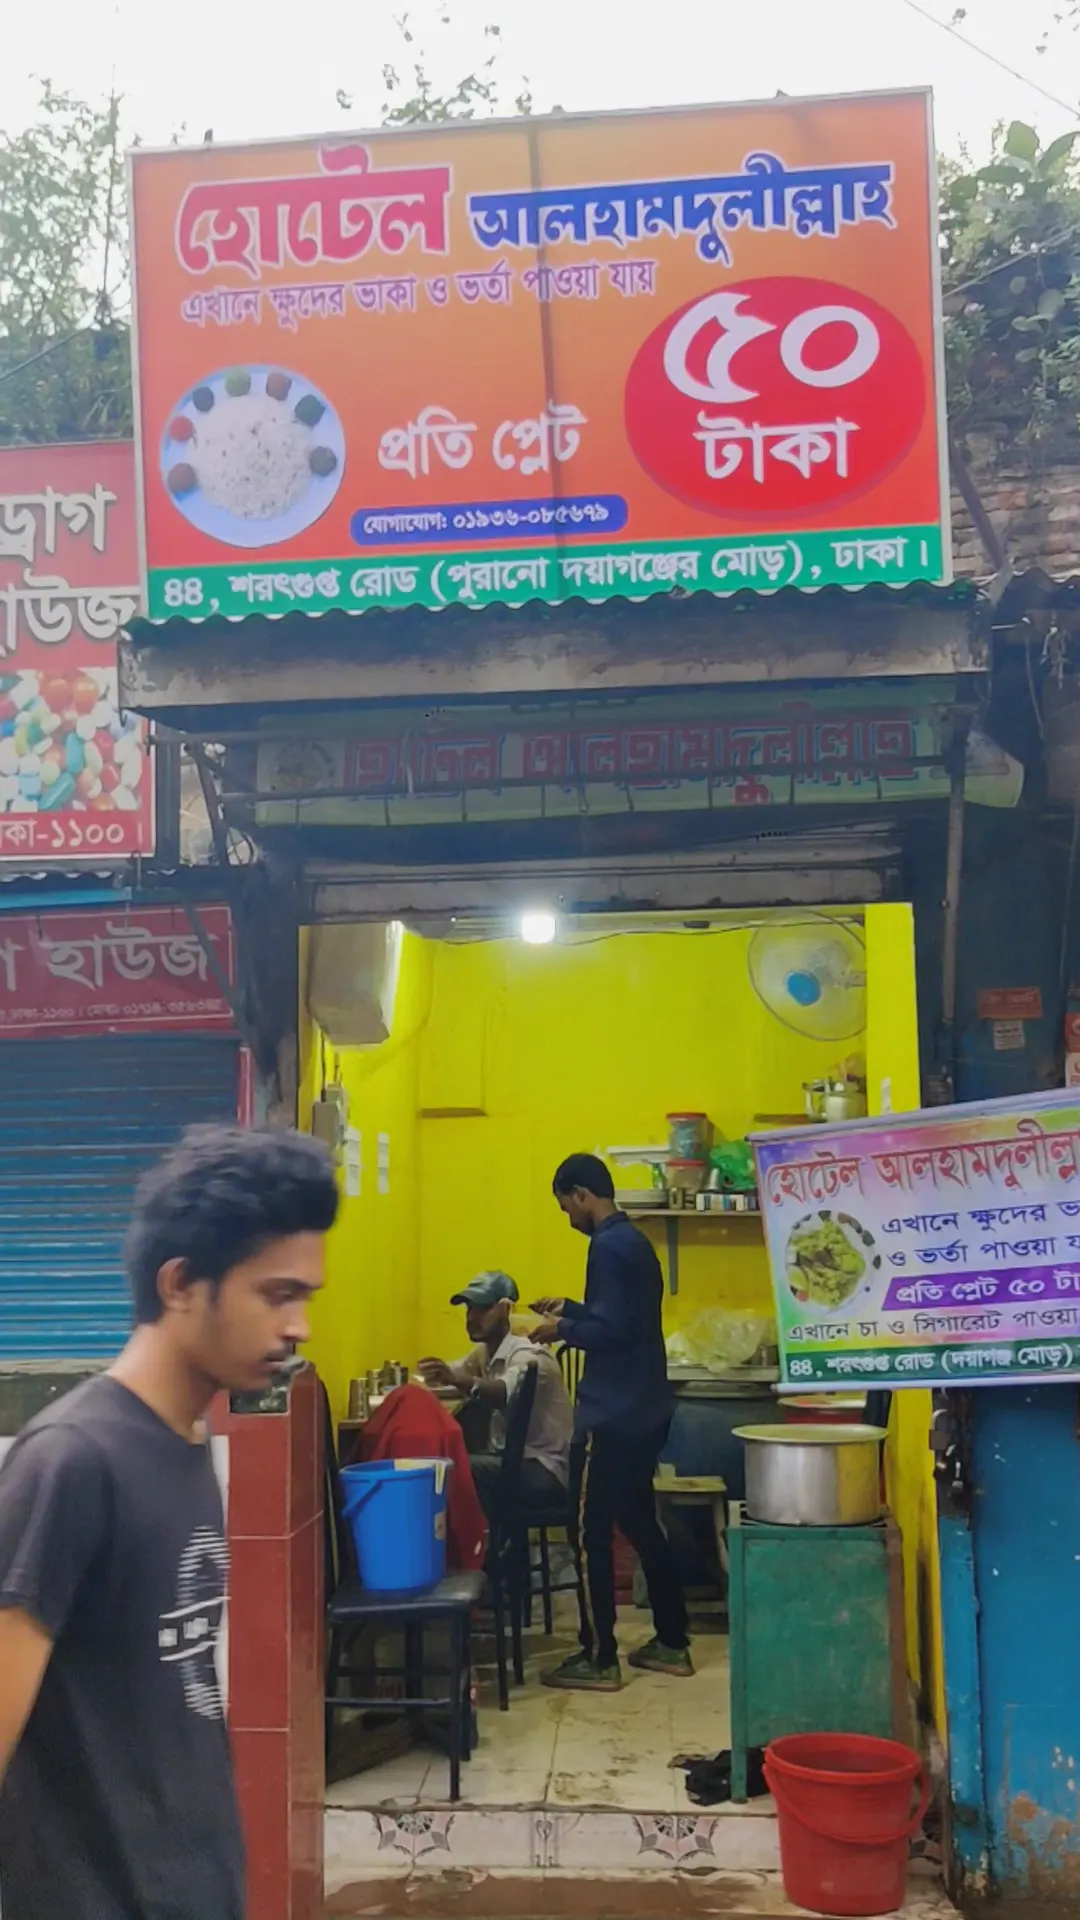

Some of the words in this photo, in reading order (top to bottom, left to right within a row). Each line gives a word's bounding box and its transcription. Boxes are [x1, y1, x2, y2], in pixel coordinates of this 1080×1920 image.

[177, 143, 451, 277] হোটেল
[469, 151, 895, 266] আলহামদুলীল্লাহ
[182, 286, 260, 325] এখানে
[269, 282, 345, 330] ক্ষুদের
[426, 278, 448, 306] ও
[456, 260, 511, 305] ভর্তা
[522, 263, 599, 301] পাওয়া
[609, 259, 656, 296] যায়
[663, 292, 880, 404] ৫০
[377, 405, 478, 479] প্রতি
[492, 400, 588, 476] প্লেট
[693, 410, 860, 484] টাকা
[453, 506, 609, 529] ০১৯৩৬-০৮৫৬৭৯
[350, 564, 420, 597] রোড
[430, 559, 550, 602] (পুরানো
[561, 550, 701, 586] দয়াগঞ্জের
[0, 568, 140, 657] াউজ
[39, 921, 221, 991] হাউজ
[768, 1151, 865, 1205] হোটেল
[872, 1118, 1080, 1189] আলহামদুলীল্ল
[882, 1209, 961, 1235] এখানে
[968, 1202, 1047, 1232] ক্ষুদের
[888, 1250, 906, 1268] ও
[917, 1239, 968, 1264] ভর্তা
[980, 1236, 1061, 1260] পাওয়া
[895, 1280, 945, 1304] প্রতি
[951, 1276, 1000, 1301] প্লেট
[1009, 1278, 1044, 1295] ৫০
[788, 1322, 849, 1343] এখানে
[859, 1320, 879, 1338] চা
[889, 1320, 906, 1336] ও
[914, 1311, 1003, 1333] সিগারেট
[1013, 1308, 1080, 1328] পাওয়া
[895, 1353, 935, 1373] রোড
